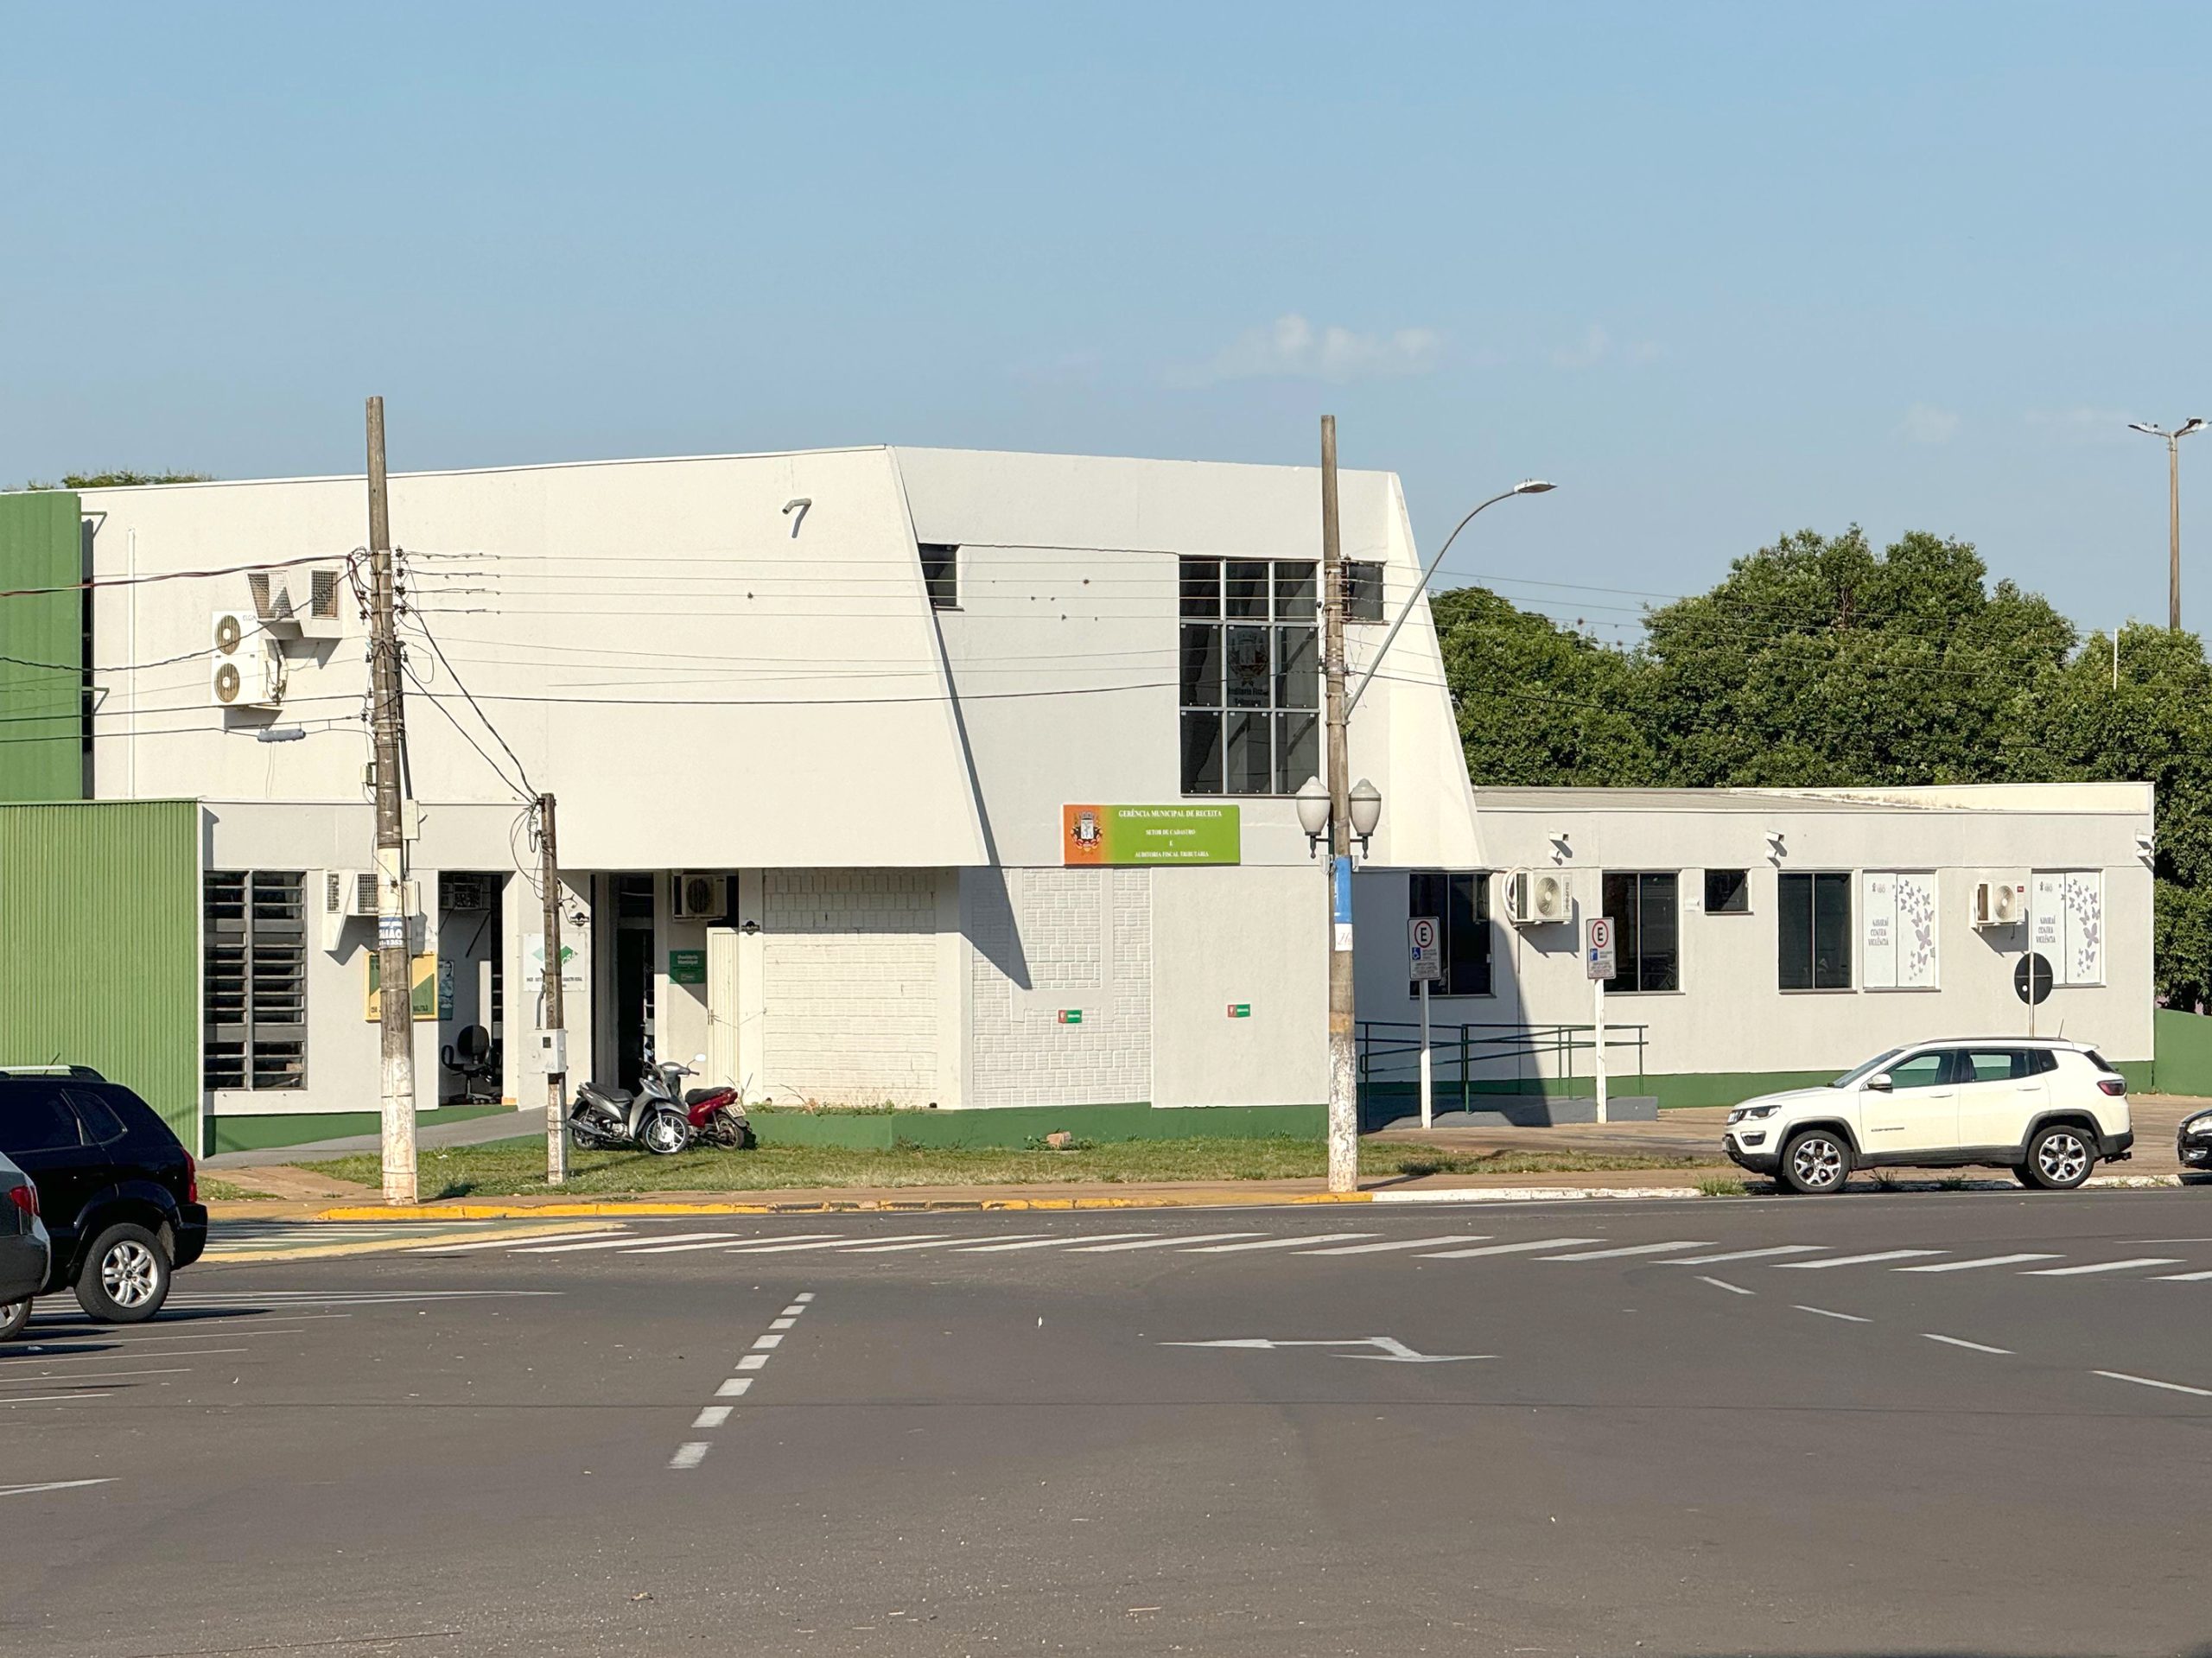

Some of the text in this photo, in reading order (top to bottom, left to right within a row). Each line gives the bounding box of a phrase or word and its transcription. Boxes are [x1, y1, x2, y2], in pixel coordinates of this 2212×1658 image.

[1118, 809, 1150, 817] GERÊNCIA
[1420, 927, 1427, 942] E
[1598, 926, 1604, 941] E
